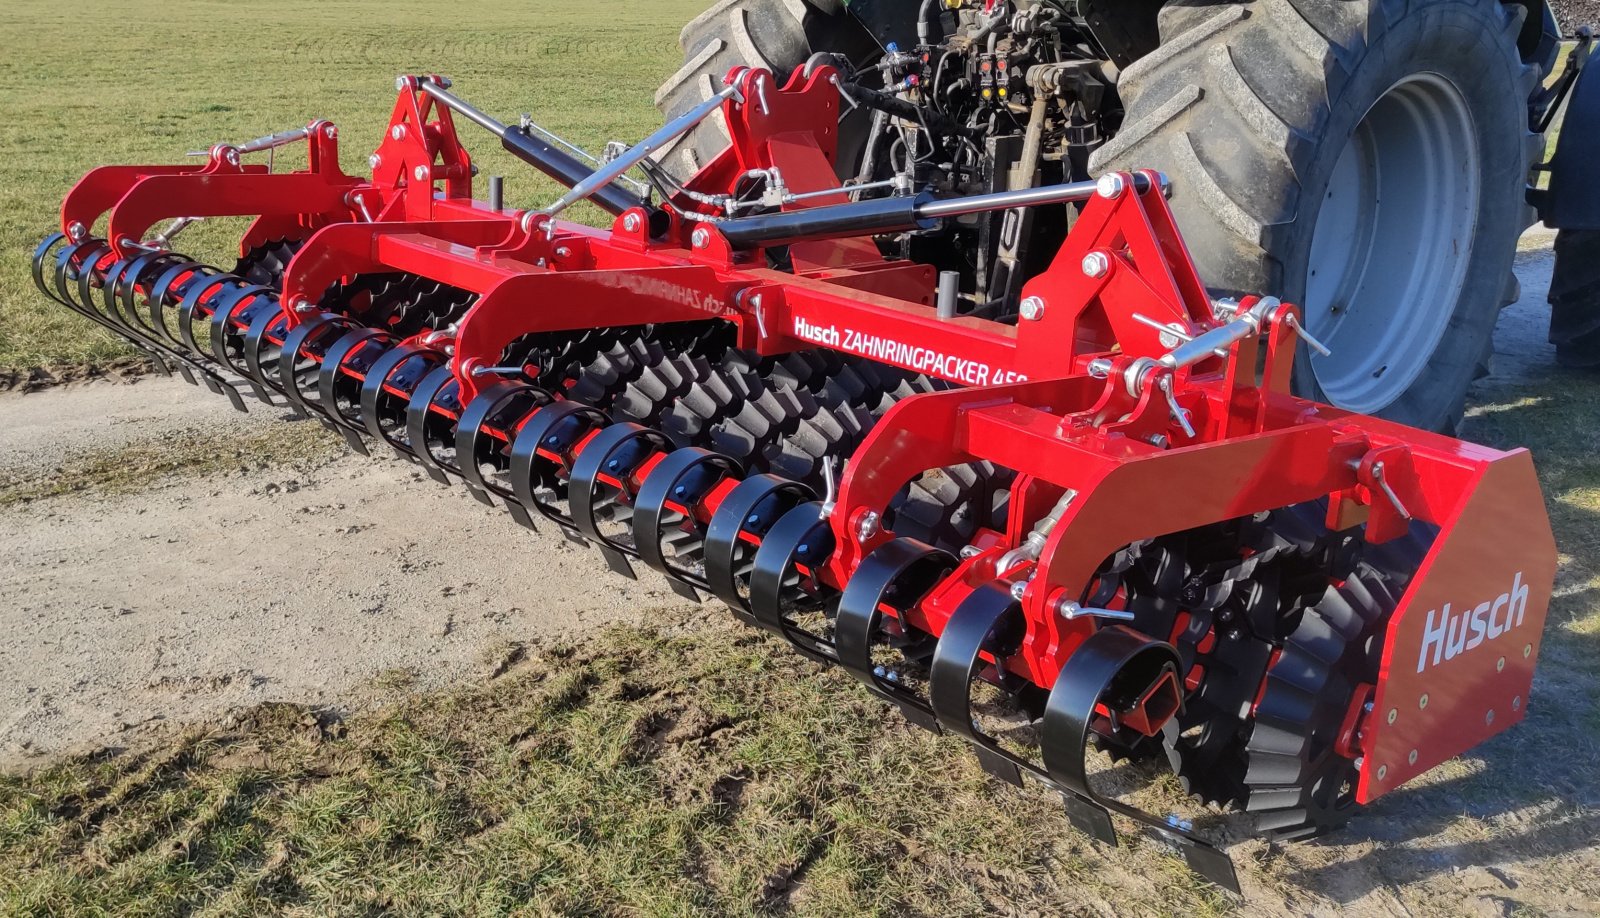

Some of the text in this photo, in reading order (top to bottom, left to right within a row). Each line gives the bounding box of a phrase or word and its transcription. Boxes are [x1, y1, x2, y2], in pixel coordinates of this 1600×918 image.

[794, 316, 840, 347] Husch
[842, 329, 990, 387] ZAHNRINGPACKER
[1416, 571, 1529, 674] Husch
